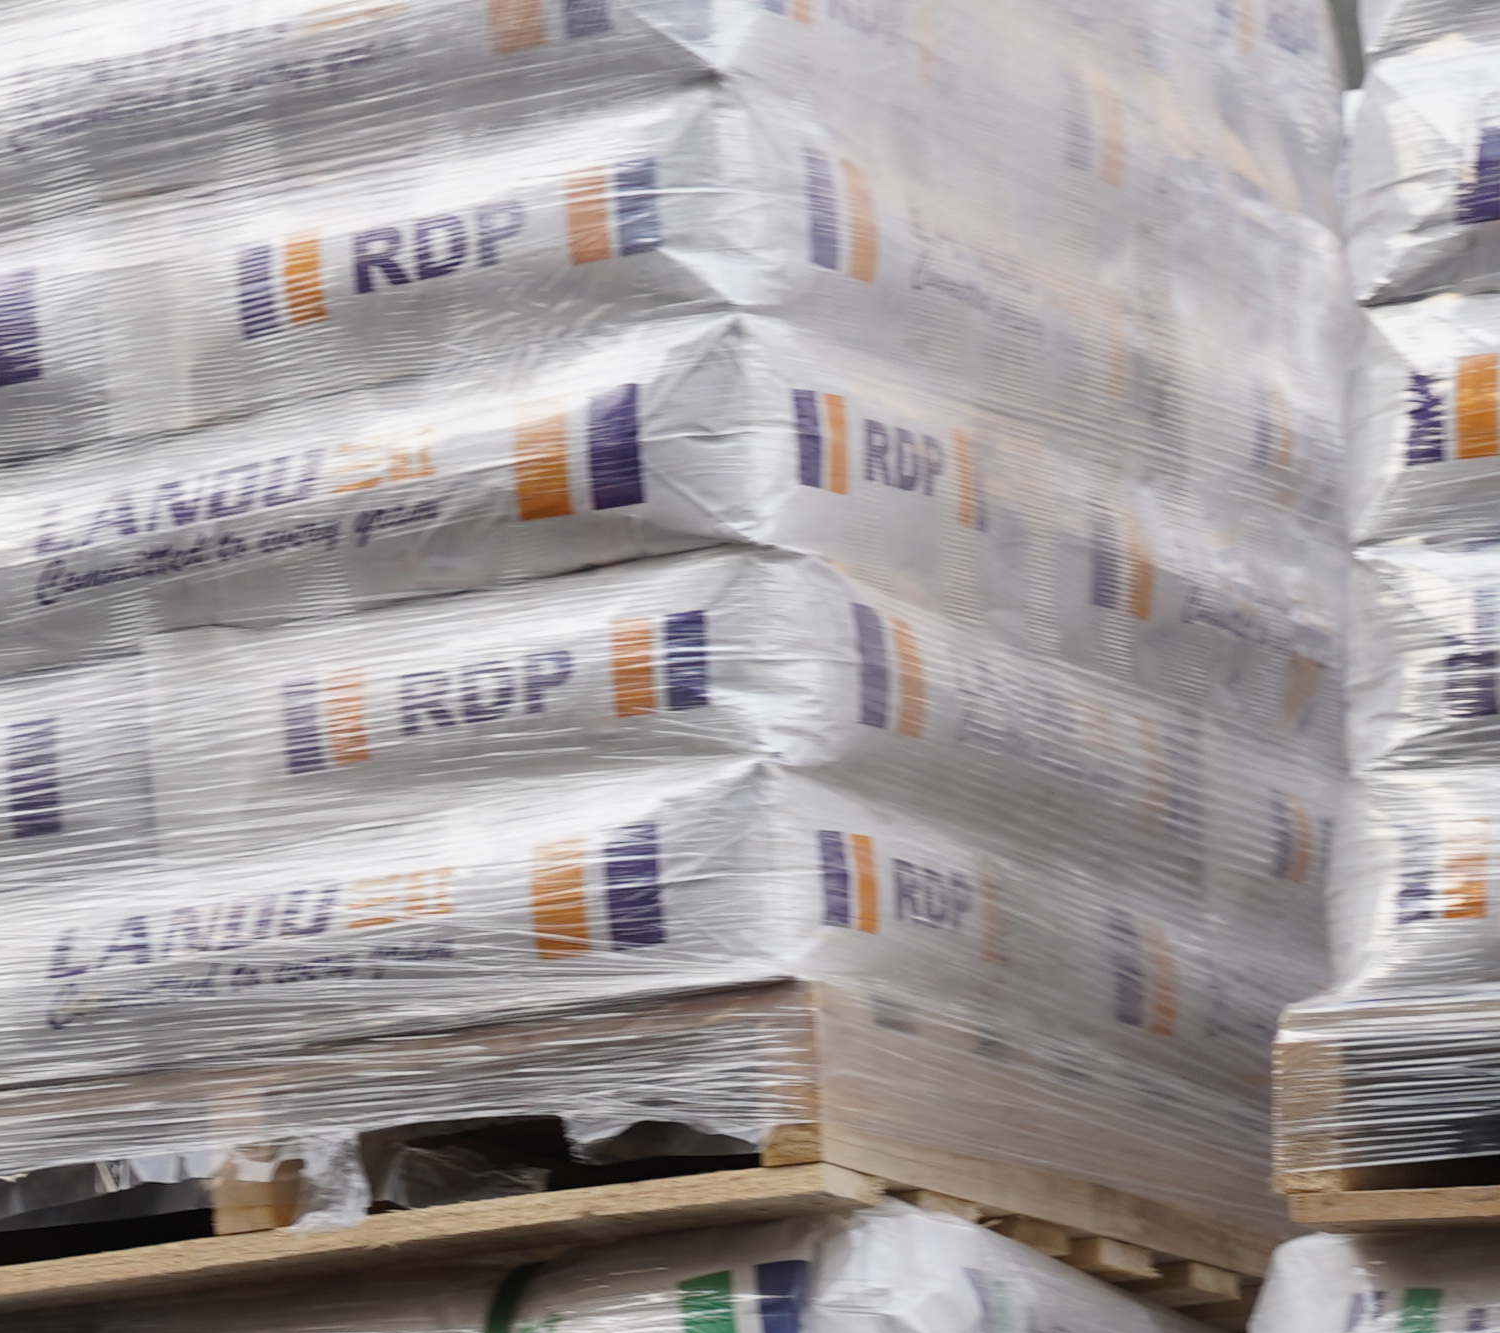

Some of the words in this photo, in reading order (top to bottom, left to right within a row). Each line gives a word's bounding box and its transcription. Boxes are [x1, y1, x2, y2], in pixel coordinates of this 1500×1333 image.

[354, 198, 525, 295] RDP
[862, 416, 944, 498] RDP
[36, 532, 205, 607] Committed
[401, 648, 575, 737] RDP
